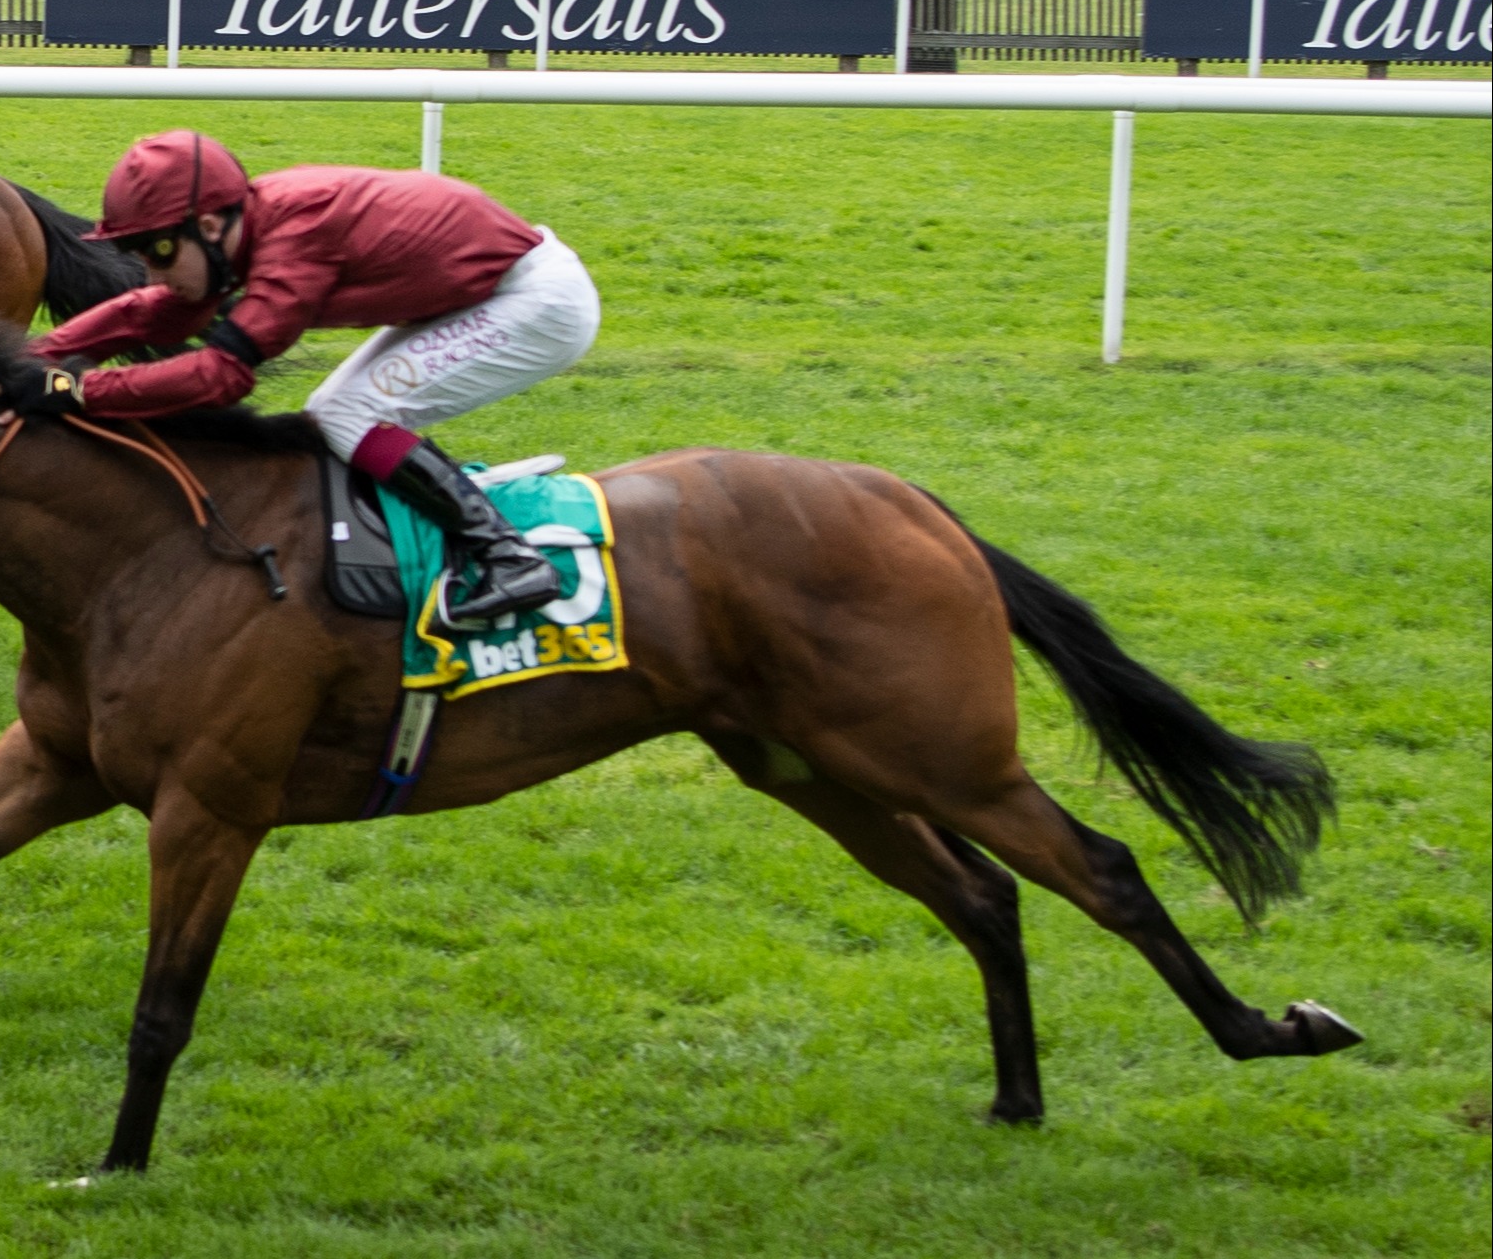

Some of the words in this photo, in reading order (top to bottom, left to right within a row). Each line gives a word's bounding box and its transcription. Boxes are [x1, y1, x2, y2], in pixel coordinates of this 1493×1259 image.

[408, 308, 495, 355] QATAR
[423, 330, 510, 376] RACING
[468, 622, 616, 678] bet365
